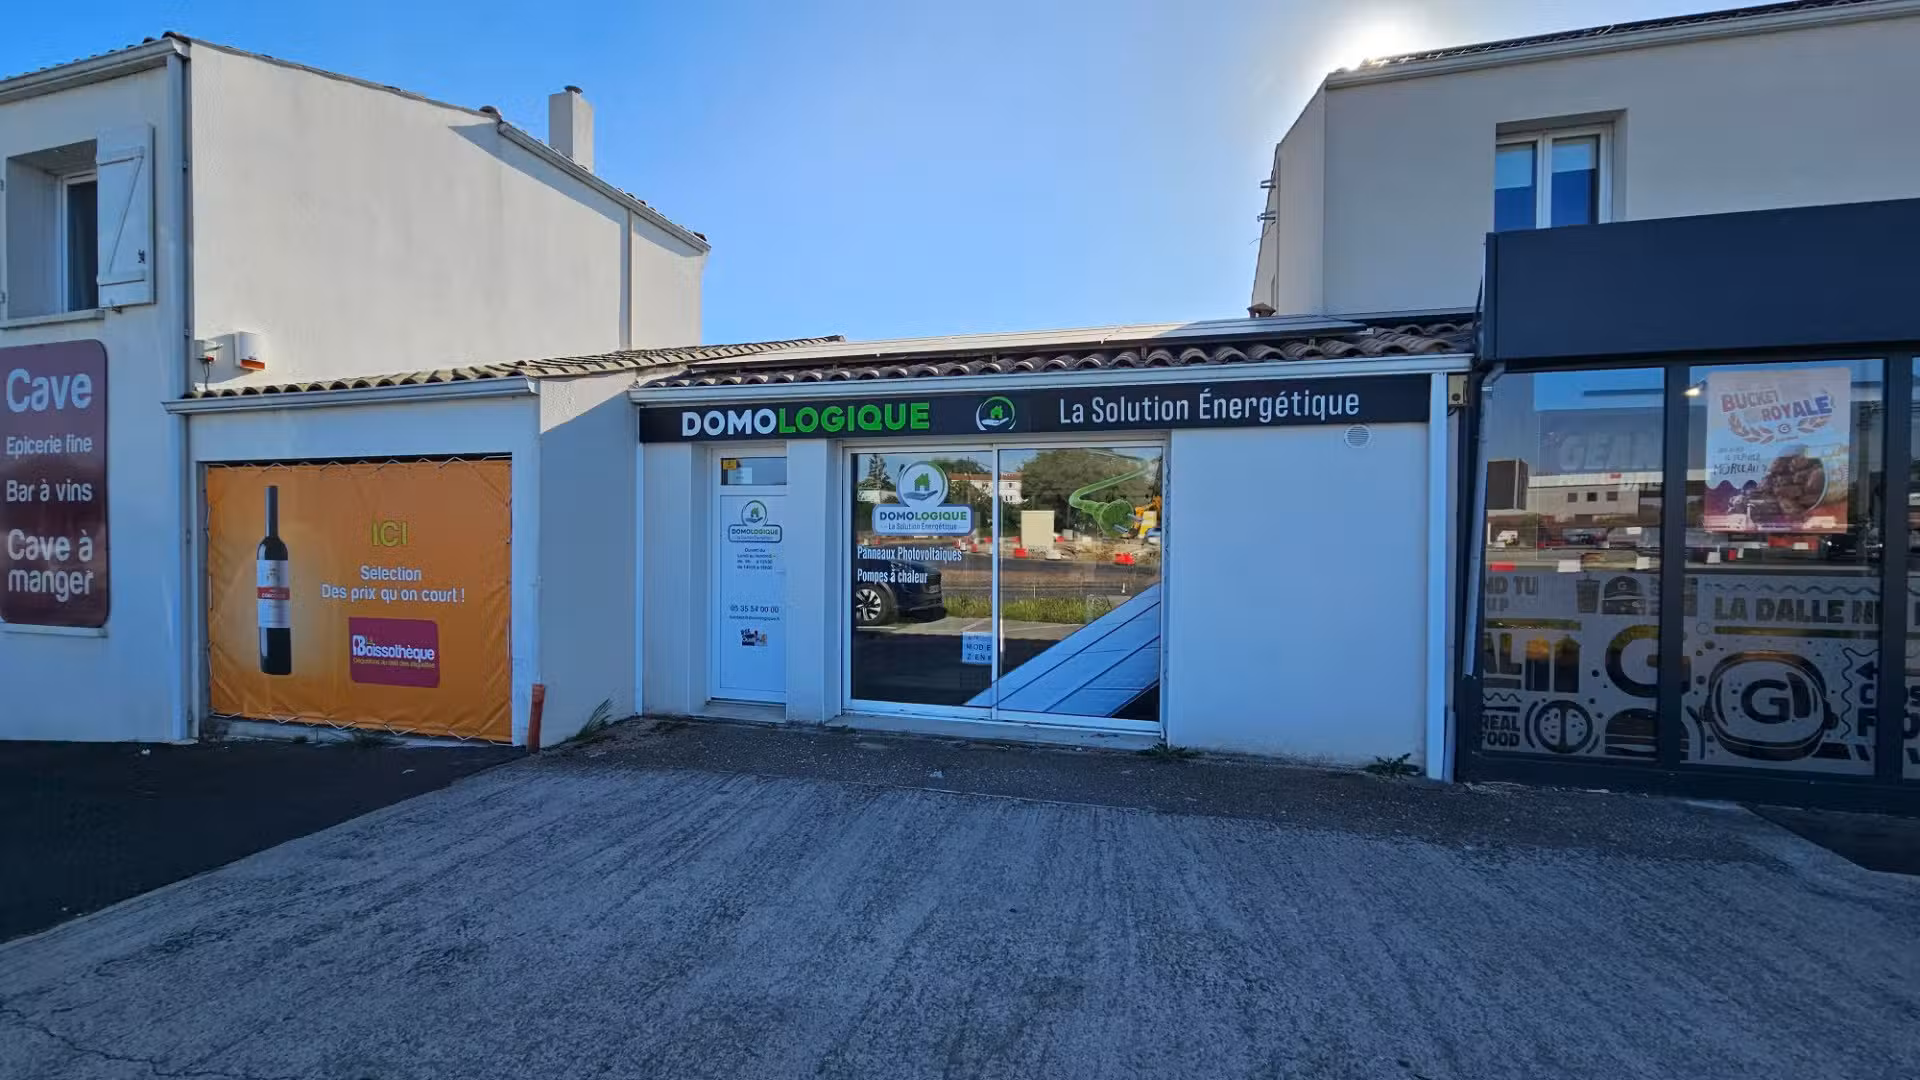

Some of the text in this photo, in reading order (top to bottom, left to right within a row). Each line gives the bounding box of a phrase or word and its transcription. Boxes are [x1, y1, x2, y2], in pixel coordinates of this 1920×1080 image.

[7, 368, 92, 412] Cave
[1721, 390, 1778, 413] BUCKET
[681, 401, 930, 437] DOMOLOGIQUE
[1059, 388, 1360, 425] La Solution Énergétique
[1760, 394, 1833, 422] ROYALE
[6, 433, 93, 460] Epicerie fine
[6, 478, 93, 502] Bar à vins
[879, 511, 967, 521] DOMOLOGIQUE
[888, 522, 895, 530] La
[896, 522, 921, 530] Solution
[7, 528, 93, 562] Cave à
[371, 520, 409, 547] ICI
[857, 546, 962, 564] Panneaux Photovoltaïques
[8, 569, 94, 602] manger
[857, 568, 929, 585] Pompes à chaleur
[321, 584, 347, 599] Des
[351, 585, 376, 603] prix
[421, 587, 458, 603] court
[1714, 597, 1749, 621] LA
[1755, 598, 1845, 624] DALLE
